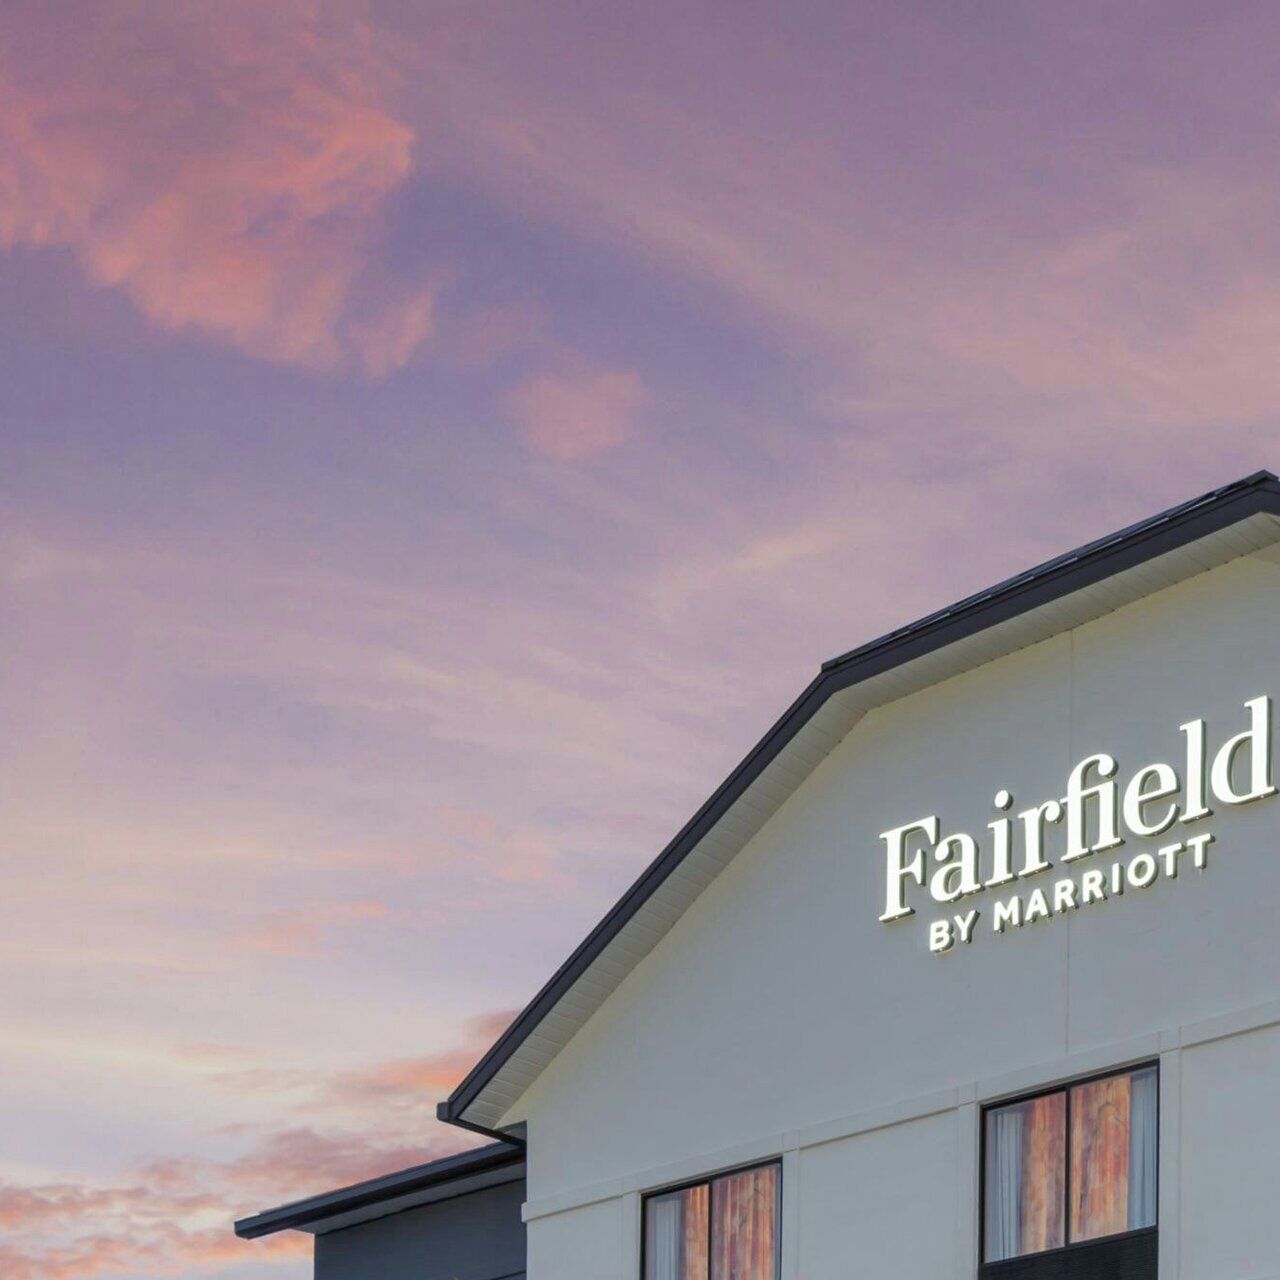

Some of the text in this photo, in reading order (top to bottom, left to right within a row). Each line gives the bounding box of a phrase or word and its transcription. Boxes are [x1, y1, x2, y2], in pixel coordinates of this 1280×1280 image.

[879, 696, 1278, 922] Fairfield
[929, 833, 1215, 953] BY MARRIOTT
